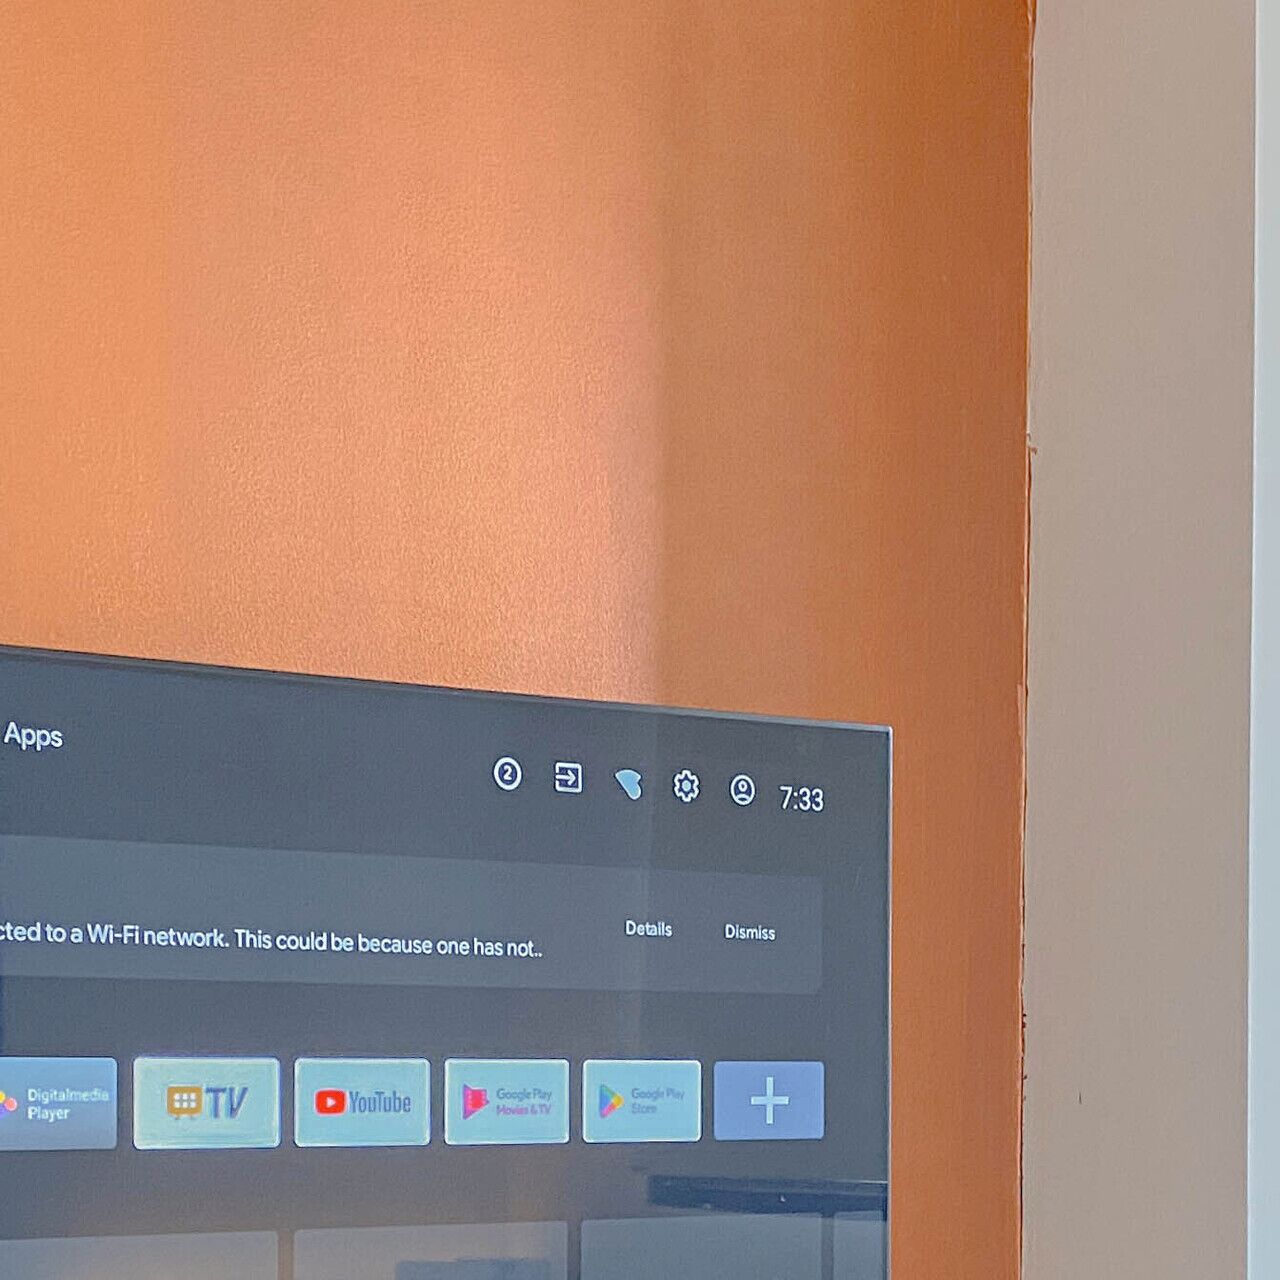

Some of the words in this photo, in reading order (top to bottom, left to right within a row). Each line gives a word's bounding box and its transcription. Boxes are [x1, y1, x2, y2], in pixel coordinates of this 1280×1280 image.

[3, 721, 63, 750] Apps
[779, 785, 825, 811] 7:33
[625, 920, 673, 938] Details
[725, 923, 776, 941] Dismiss
[45, 924, 67, 943] to
[70, 928, 84, 943] a
[87, 923, 141, 945] Wi-Fi
[143, 928, 230, 948] network.
[234, 928, 272, 949] This
[275, 931, 328, 951] could
[330, 932, 355, 951] be
[358, 933, 433, 955] because
[437, 938, 471, 956] one
[473, 937, 504, 957] has
[205, 1087, 248, 1118] TV
[348, 1090, 412, 1113] YouTube
[496, 1088, 532, 1102] Google
[533, 1088, 553, 1102] Play
[631, 1088, 665, 1102] Google
[666, 1088, 686, 1102] Play
[27, 1107, 71, 1122] Player
[539, 1104, 552, 1115] TV
[631, 1103, 658, 1115] Store
